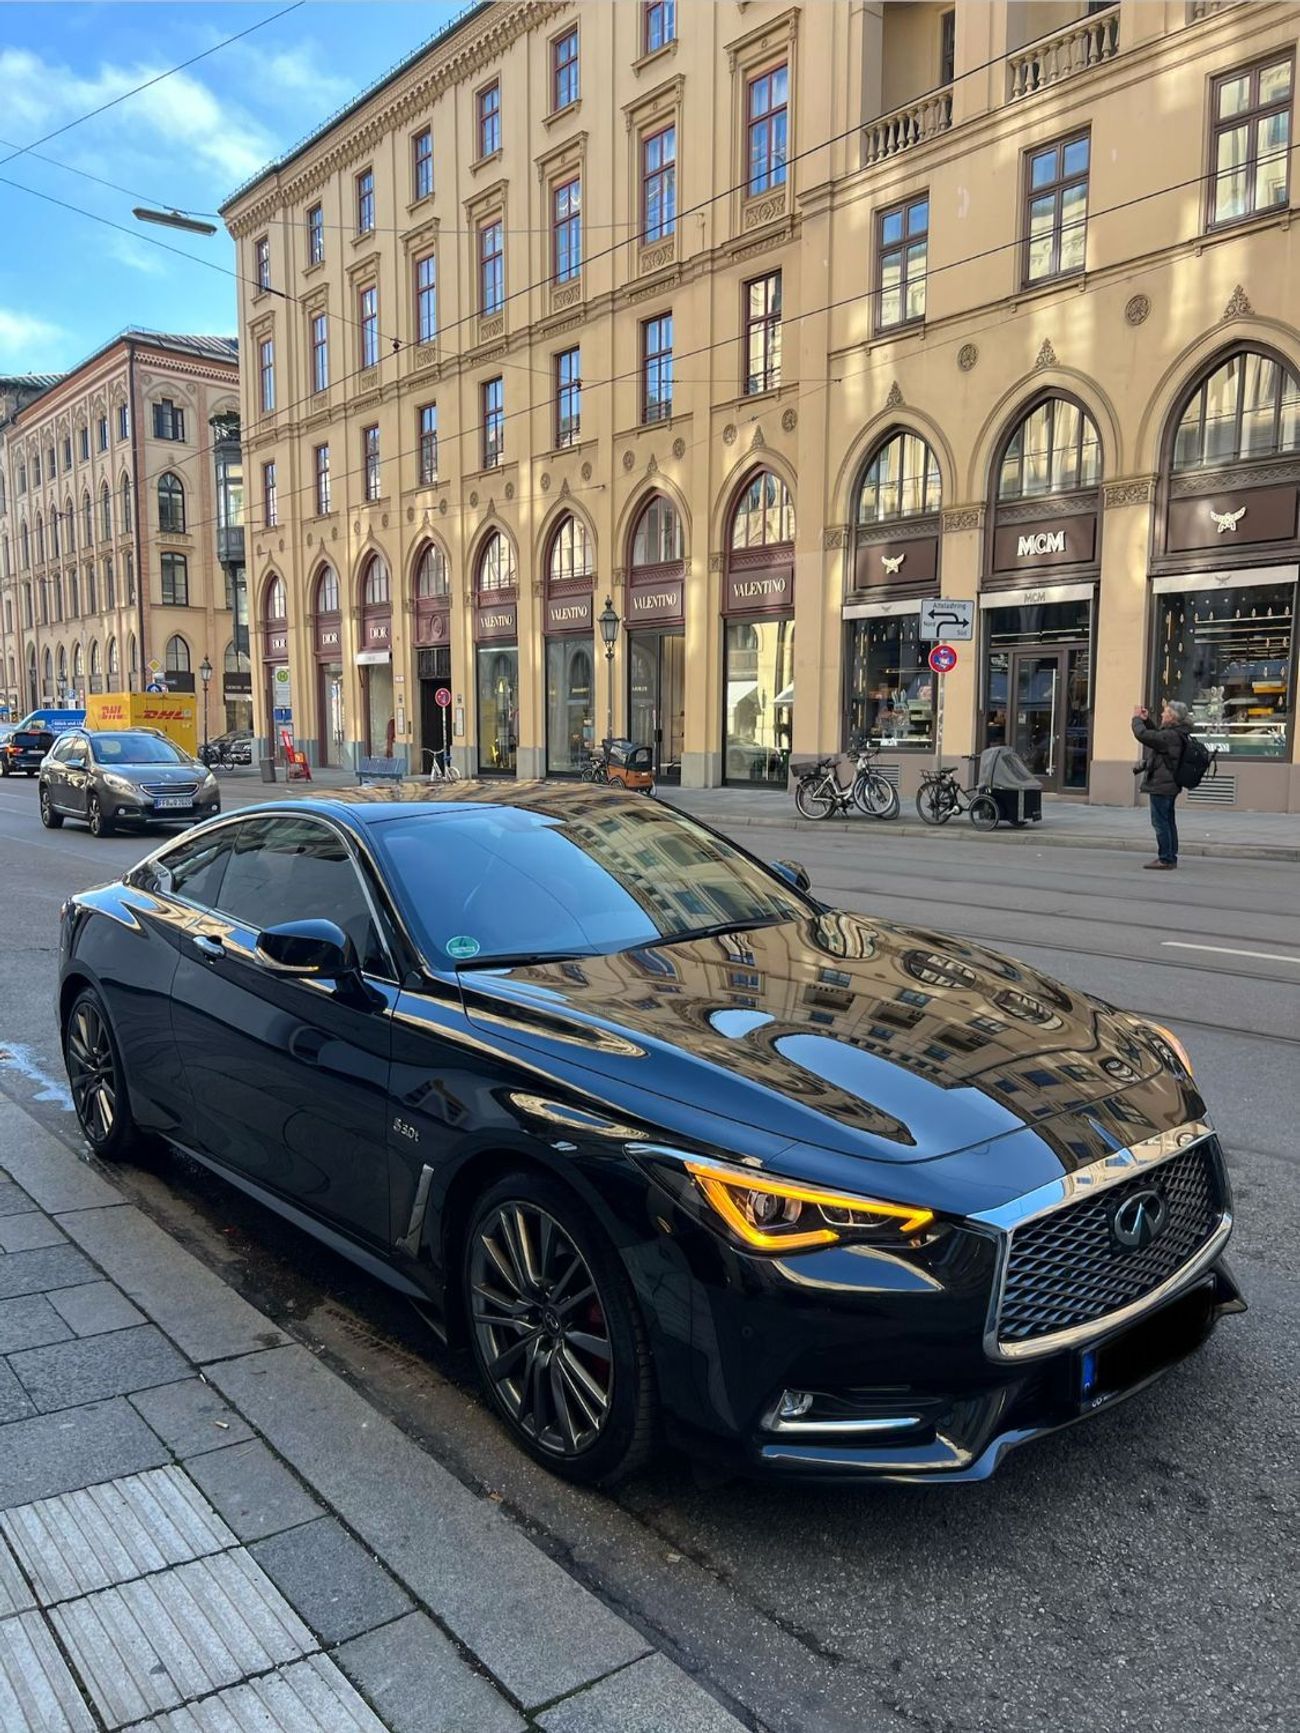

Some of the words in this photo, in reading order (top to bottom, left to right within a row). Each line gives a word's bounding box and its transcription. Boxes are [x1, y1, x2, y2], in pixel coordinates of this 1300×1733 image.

[1017, 531, 1065, 556] MCM
[733, 577, 786, 598] VALENTINO
[633, 592, 677, 610] VALENTINO
[1024, 592, 1046, 603] MCM
[551, 605, 588, 621] VALENTINO
[480, 615, 513, 628] VALENTINO
[322, 633, 339, 645] DIOR
[369, 627, 389, 639] DIOR
[272, 639, 287, 649] DIOR
[144, 710, 184, 720] DHL
